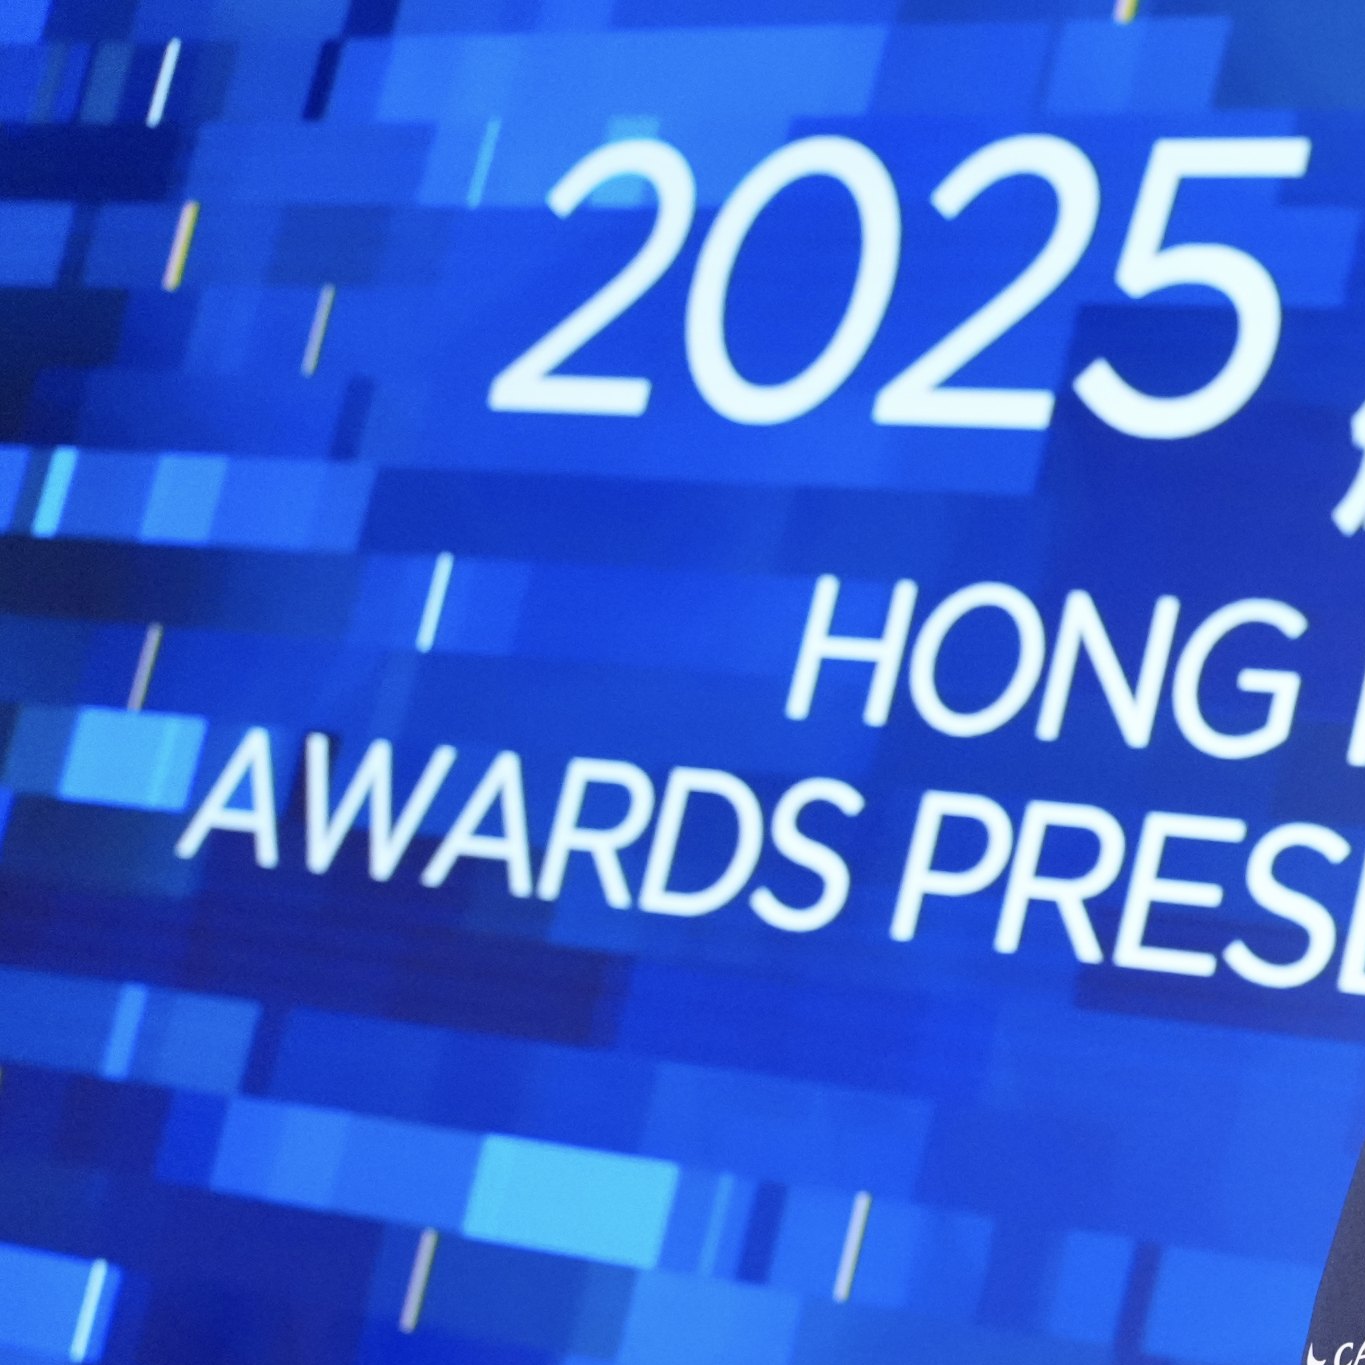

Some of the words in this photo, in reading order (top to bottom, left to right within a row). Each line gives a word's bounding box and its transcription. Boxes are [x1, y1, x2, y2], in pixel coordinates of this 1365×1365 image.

[489, 134, 1311, 440] 2025
[785, 574, 1308, 760] HONG
[177, 727, 865, 933] AWARDS
